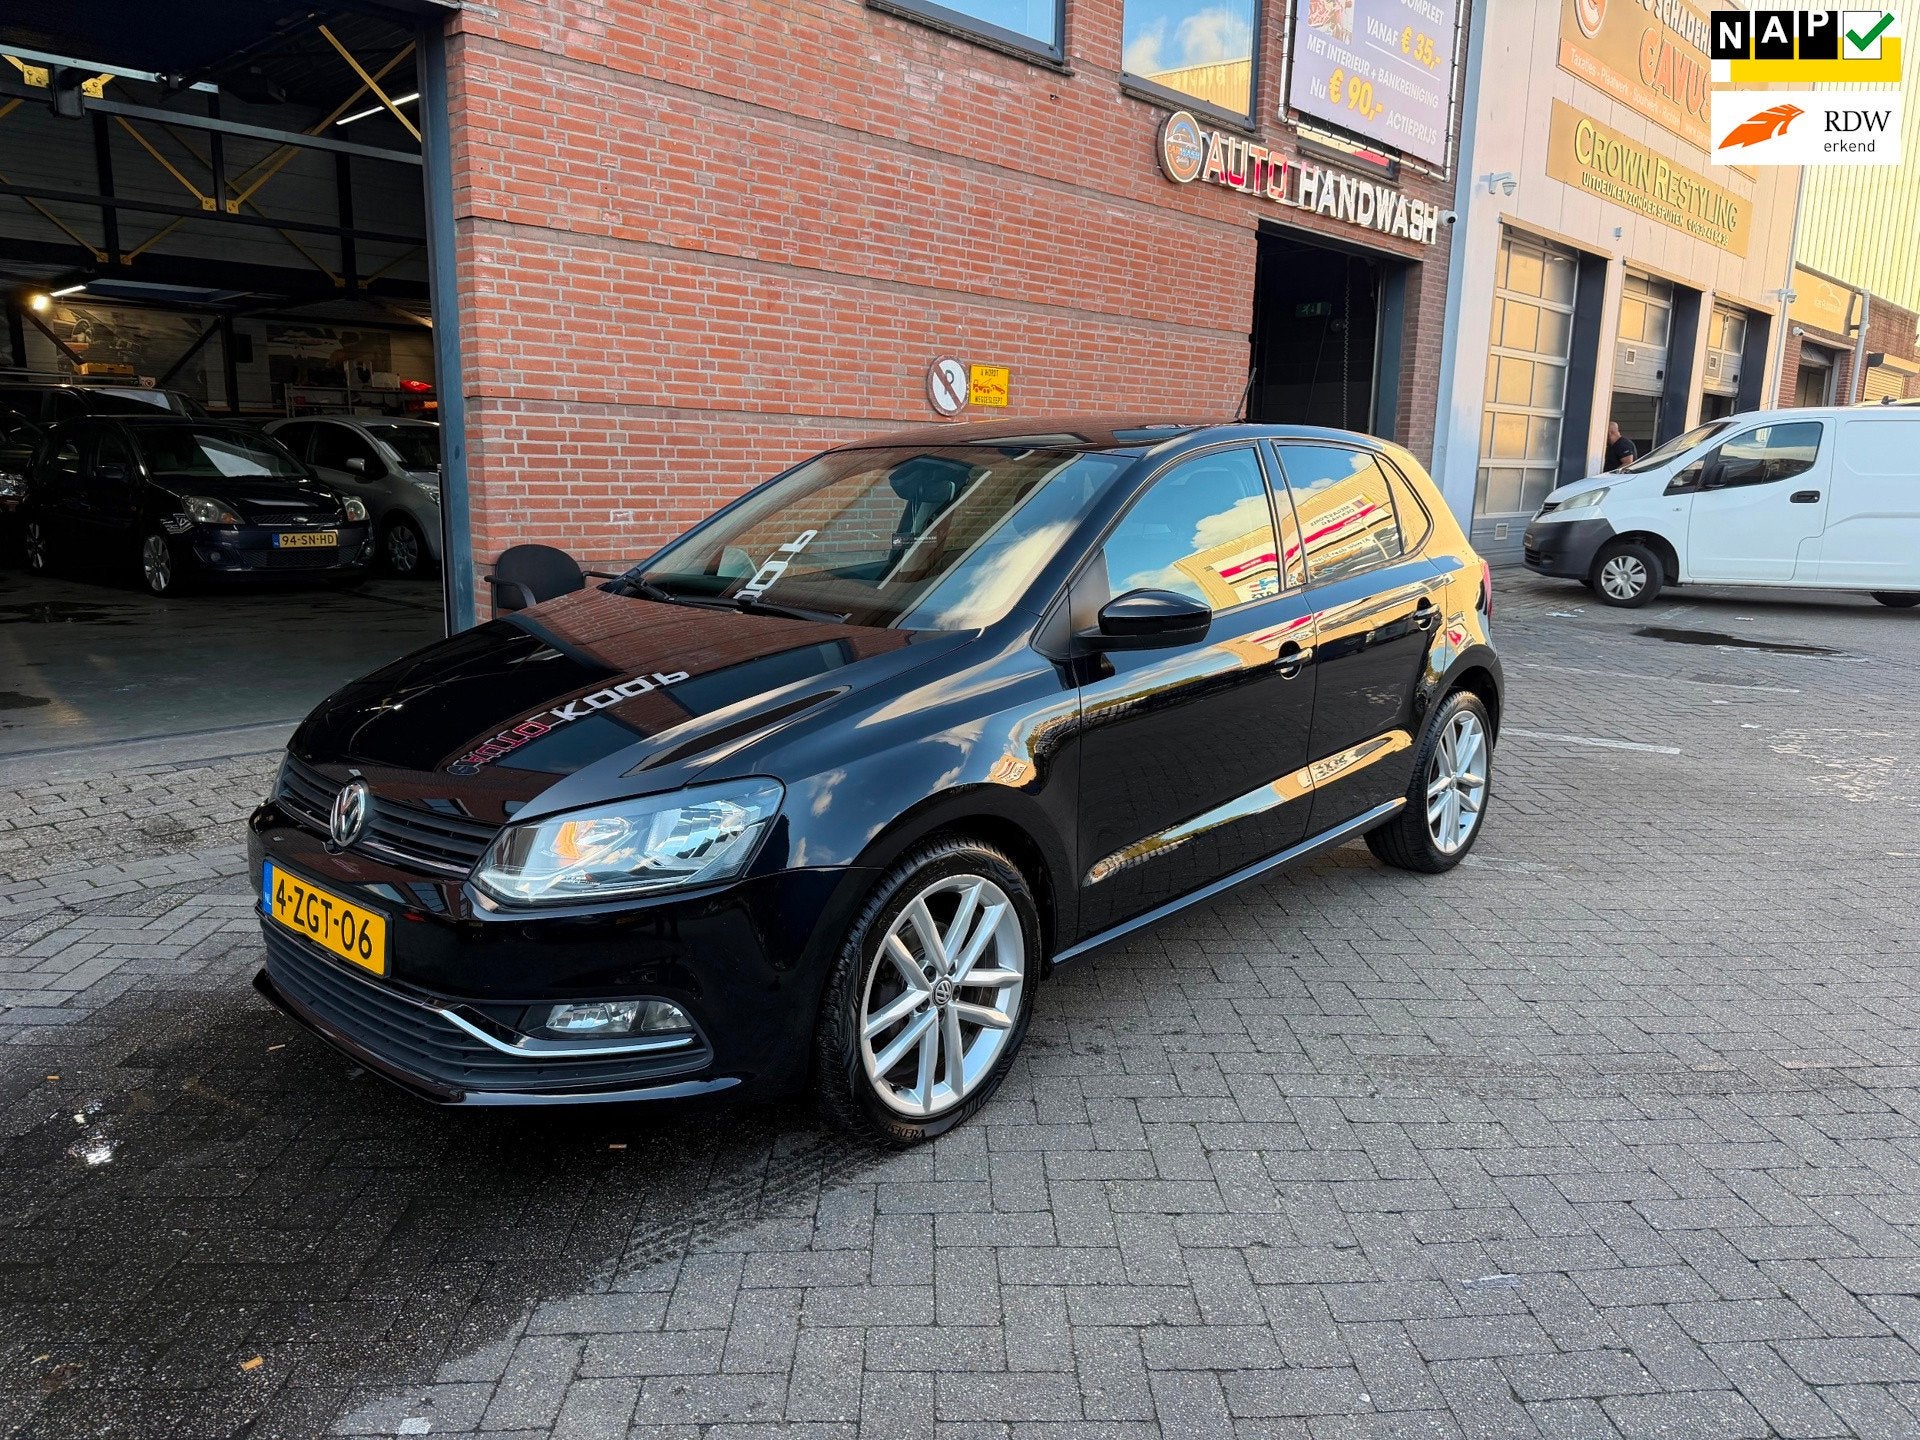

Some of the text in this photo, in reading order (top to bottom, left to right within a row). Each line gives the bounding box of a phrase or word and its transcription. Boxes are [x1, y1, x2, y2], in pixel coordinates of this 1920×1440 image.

[1366, 16, 1398, 47] VANAF
[1401, 25, 1413, 54] €
[1307, 34, 1327, 56] MET
[1327, 44, 1370, 76] INTERIEUR
[1378, 68, 1439, 109] BANKREINIGING
[1329, 68, 1344, 104] €
[1386, 109, 1437, 145] ACTIEPRIJS
[1202, 131, 1438, 244] AUTO HANDWASH
[1574, 118, 1738, 232] CROWN RESTYLING
[281, 534, 335, 546] 94-SN-HD
[275, 878, 373, 960] 4-ZGT-06
